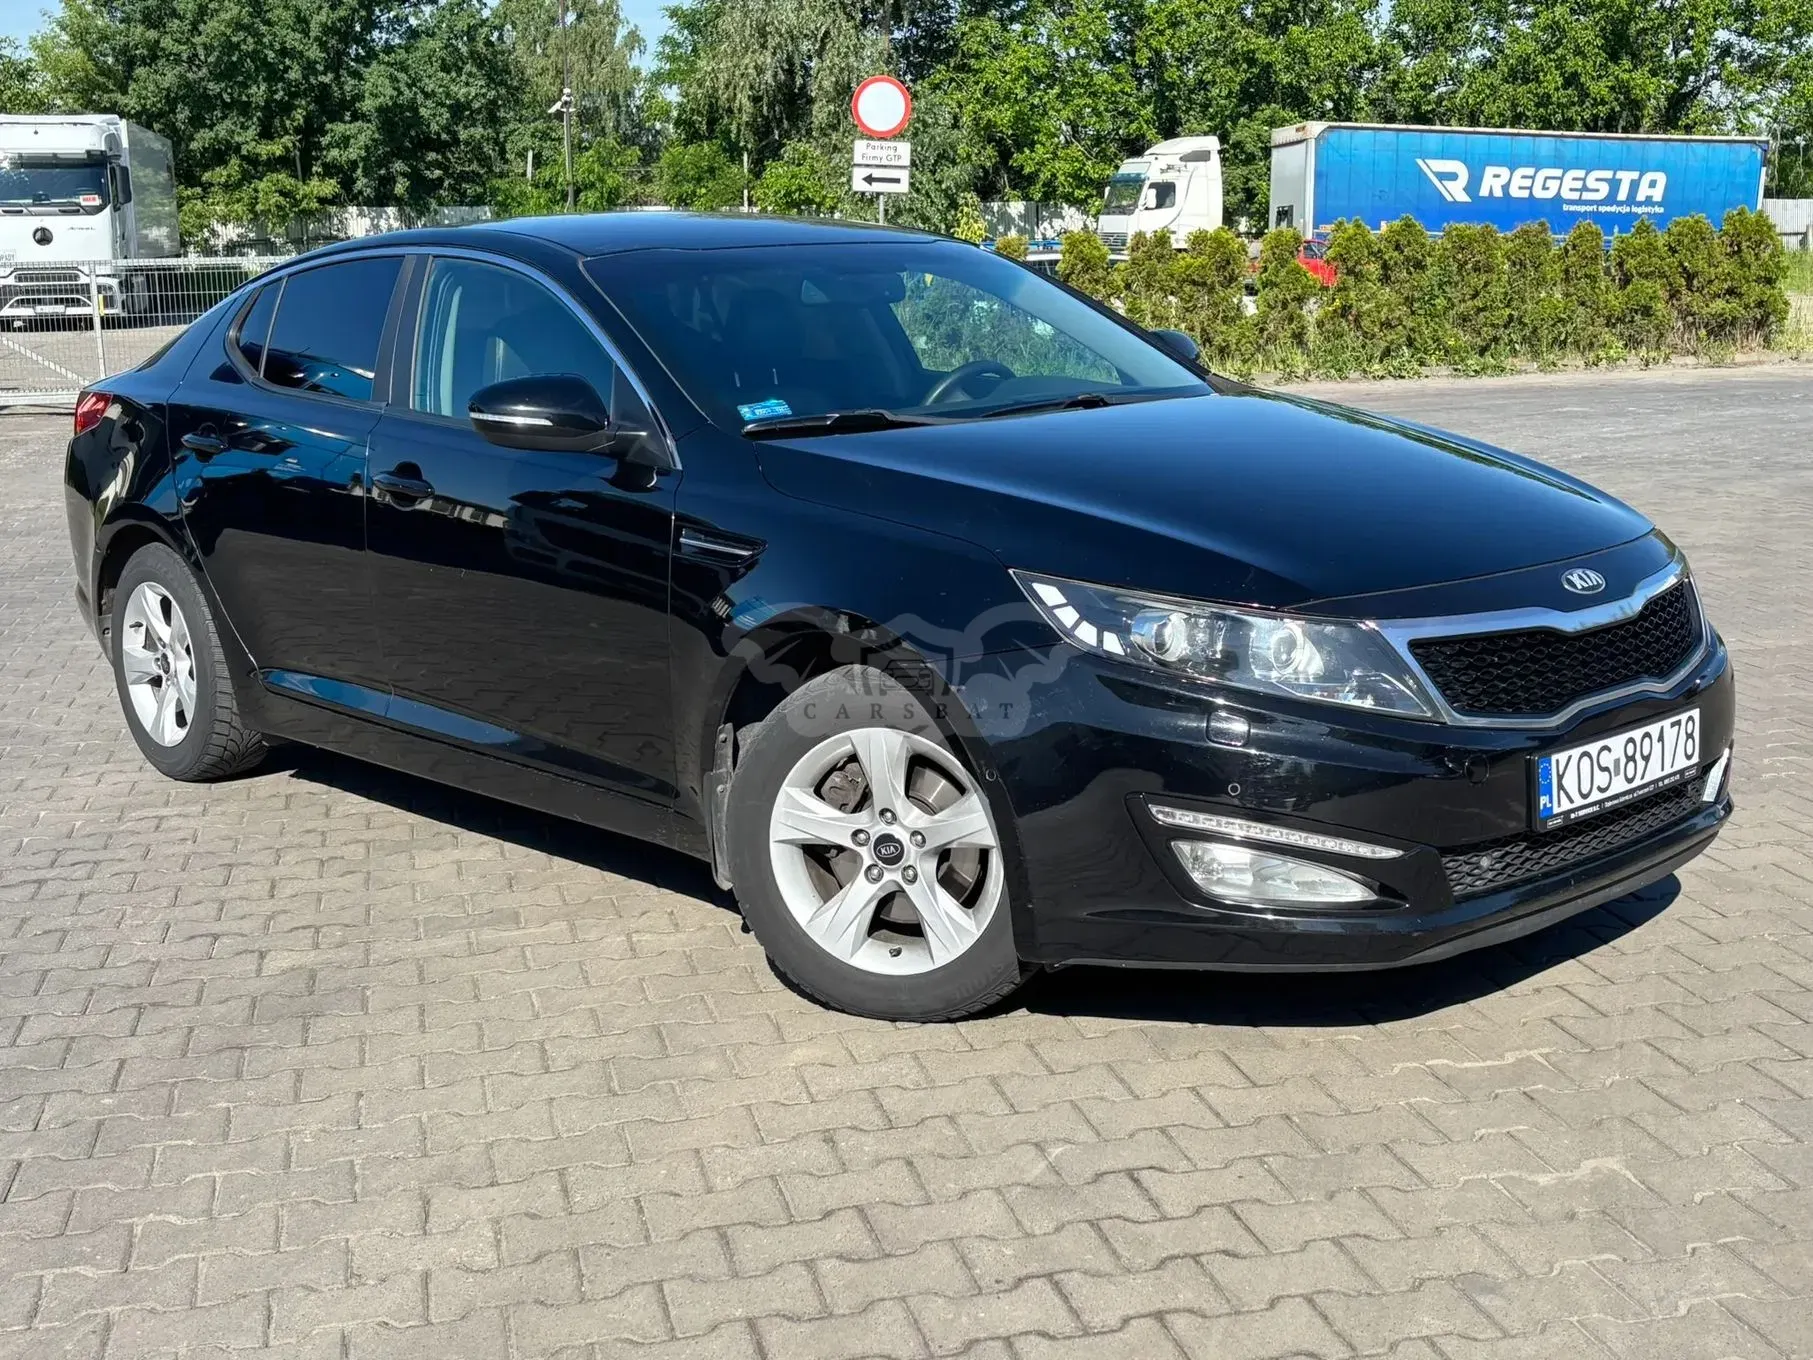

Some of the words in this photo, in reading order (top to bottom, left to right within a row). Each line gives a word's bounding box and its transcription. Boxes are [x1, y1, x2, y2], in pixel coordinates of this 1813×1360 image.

[865, 142, 898, 153] Parking
[861, 153, 884, 163] Firmy
[886, 154, 902, 163] GTP
[1478, 165, 1668, 202] REGESTA
[1562, 203, 1598, 213] transport
[1598, 204, 1631, 214] spedycja
[1631, 205, 1665, 215] logistyka
[1567, 571, 1602, 590] KIA
[1555, 744, 1613, 809] KOS
[1623, 715, 1696, 784] 89178
[1539, 795, 1552, 810] PL
[880, 846, 896, 855] KIA
